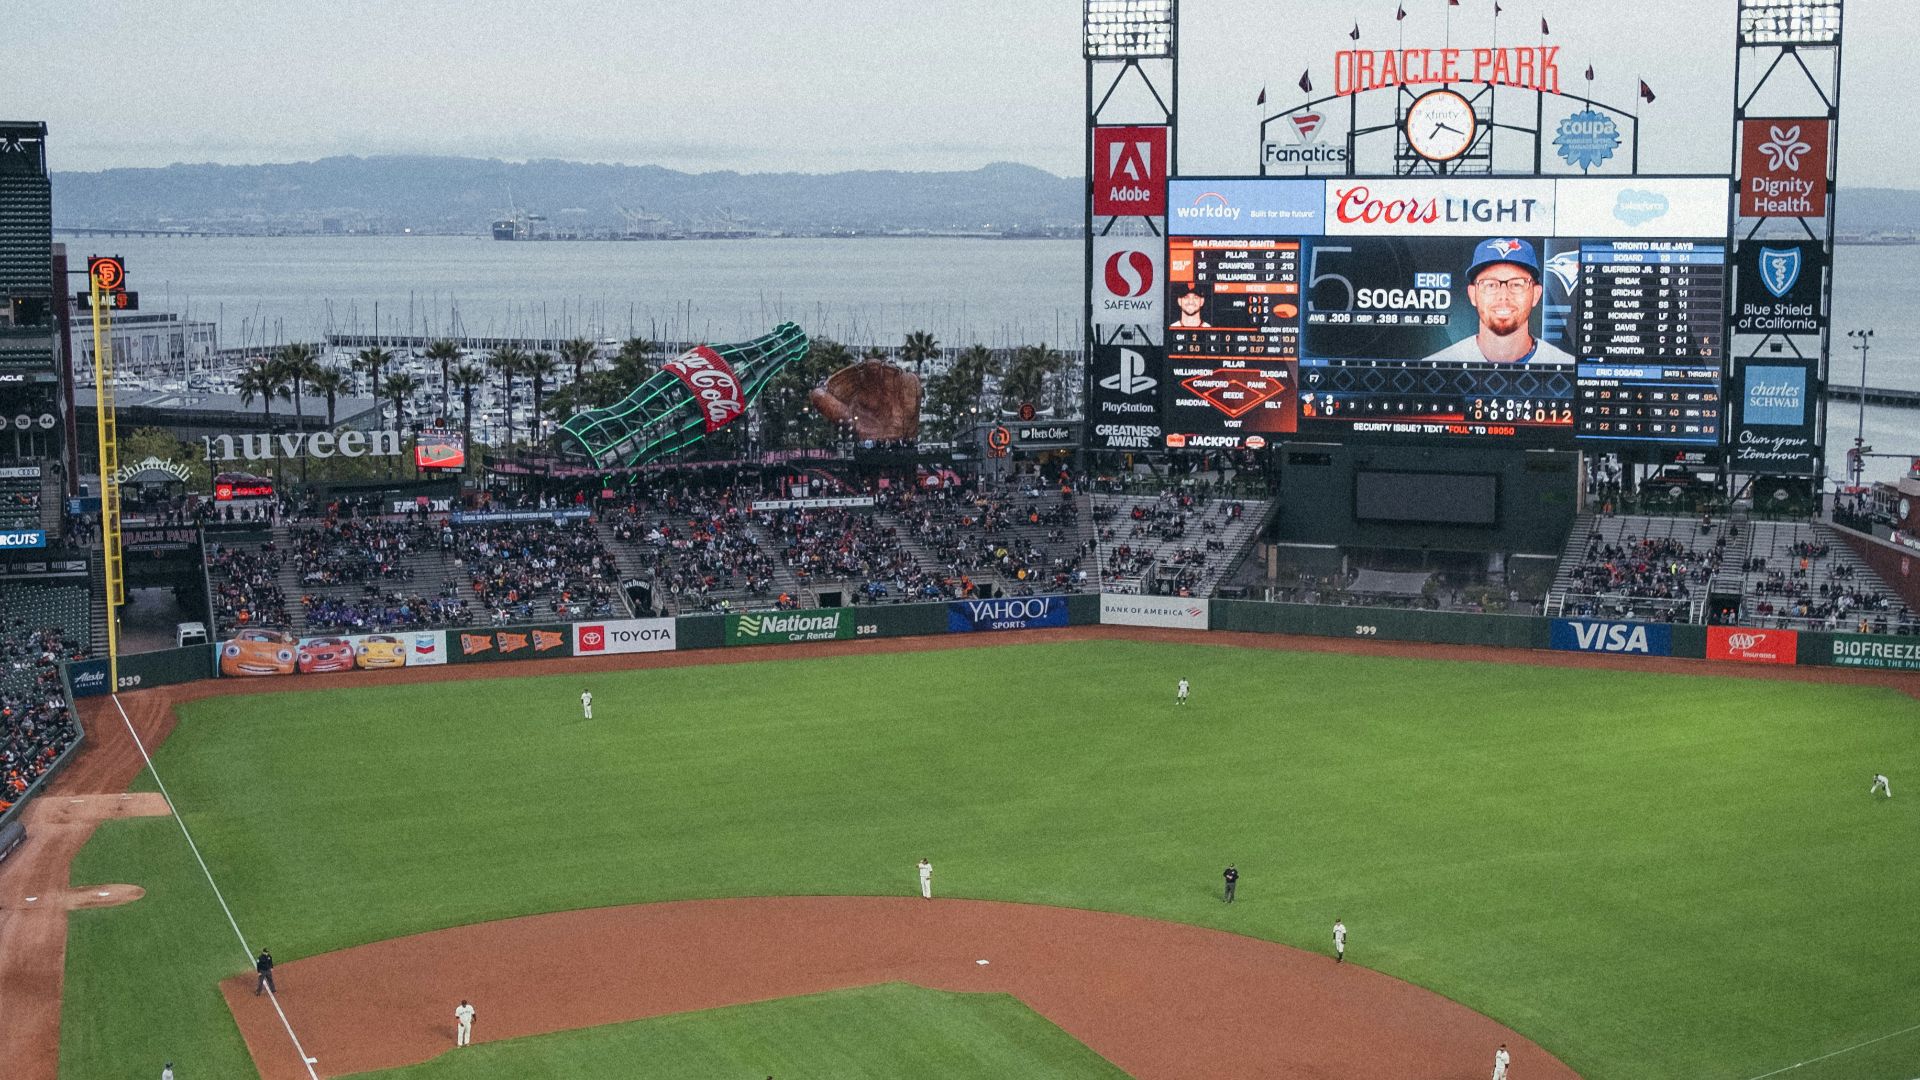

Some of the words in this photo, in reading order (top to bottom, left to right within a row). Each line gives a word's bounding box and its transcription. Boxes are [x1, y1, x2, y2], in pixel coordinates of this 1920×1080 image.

[1334, 48, 1460, 96] ORACLE
[1472, 46, 1560, 95] PARK
[1425, 110, 1459, 120] xfinity
[1562, 121, 1615, 144] coupa
[1266, 144, 1347, 163] Fanatics
[1752, 177, 1814, 196] Dignity
[1110, 186, 1150, 202] Adobe
[1336, 186, 1440, 224] Coors
[1446, 198, 1536, 223] LIGHT
[1754, 197, 1811, 212] Health
[1178, 204, 1240, 220] workday
[1308, 246, 1354, 312] 5
[1417, 273, 1450, 287] ERIC
[1104, 300, 1152, 310] SAFEWAY
[1357, 288, 1450, 309] SOGARD
[1744, 304, 1770, 315] Blue
[1774, 304, 1812, 316] Shield
[1376, 314, 1398, 324] .398
[1738, 316, 1751, 328] of
[1755, 317, 1816, 329] California
[672, 349, 741, 422] ca-Cola
[1750, 381, 1799, 396] charles
[1102, 402, 1154, 415] PlayStation
[1750, 397, 1799, 408] SCHWAB
[1536, 409, 1545, 422] 0
[1550, 410, 1556, 422] 1
[1562, 410, 1572, 422] 2
[1048, 428, 1068, 439] Coffee
[1096, 424, 1161, 436] GREATNESS
[1354, 422, 1391, 431] SECURITY
[1393, 424, 1421, 432] ISSUE?
[1423, 424, 1444, 433] TEXT
[1475, 426, 1486, 434] TO
[202, 429, 402, 461] nuveen
[1189, 436, 1240, 447] JACKPOT
[1740, 430, 1770, 444] Own
[1772, 437, 1808, 452] your
[1738, 446, 1810, 460] tomorrow
[114, 456, 194, 484] Ghirardelli
[236, 487, 272, 496] TOYOTA
[968, 598, 1050, 622] YAHOO!
[1144, 608, 1183, 616] AMERICA
[762, 612, 839, 634] National
[857, 624, 877, 635] 382
[992, 620, 1026, 630] SPORTS
[610, 629, 670, 642] TOYOTA
[789, 632, 804, 641] Car
[806, 631, 836, 640] Rental
[1355, 625, 1377, 636] 399
[1568, 622, 1649, 652] VISA
[1833, 640, 1920, 660] BIOFREEZE
[1864, 658, 1884, 666] COOL
[75, 670, 104, 682] Alaska
[118, 675, 141, 687] 339
